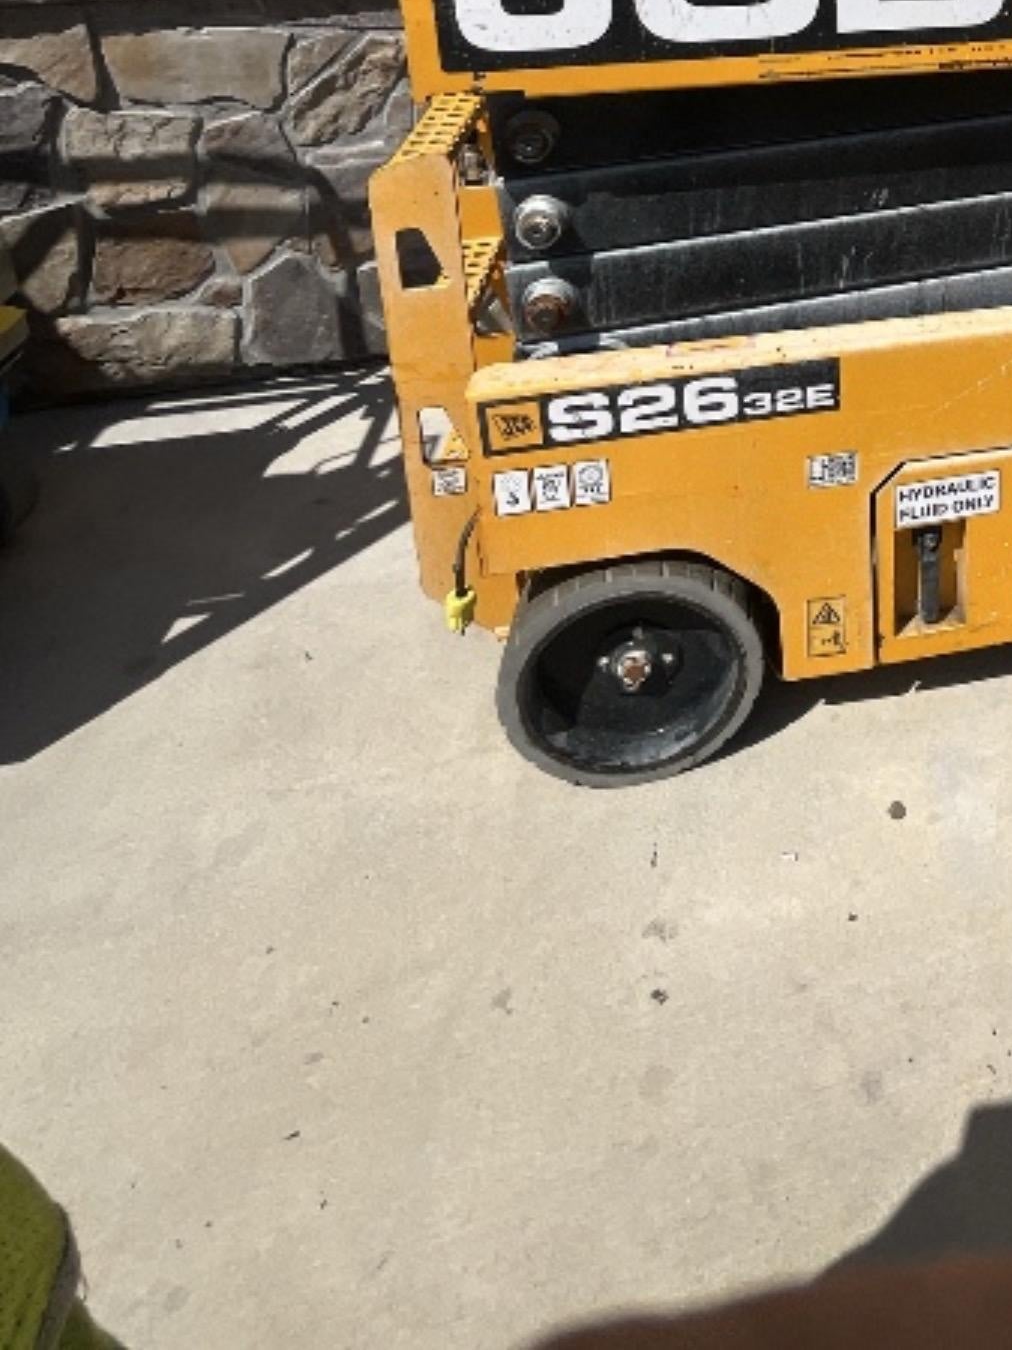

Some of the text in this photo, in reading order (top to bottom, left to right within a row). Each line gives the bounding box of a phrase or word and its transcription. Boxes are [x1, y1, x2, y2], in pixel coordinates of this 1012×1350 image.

[547, 376, 835, 443] S26 32E
[900, 476, 995, 502] HYDRAULIC
[900, 494, 994, 523] FLUID ONLY
